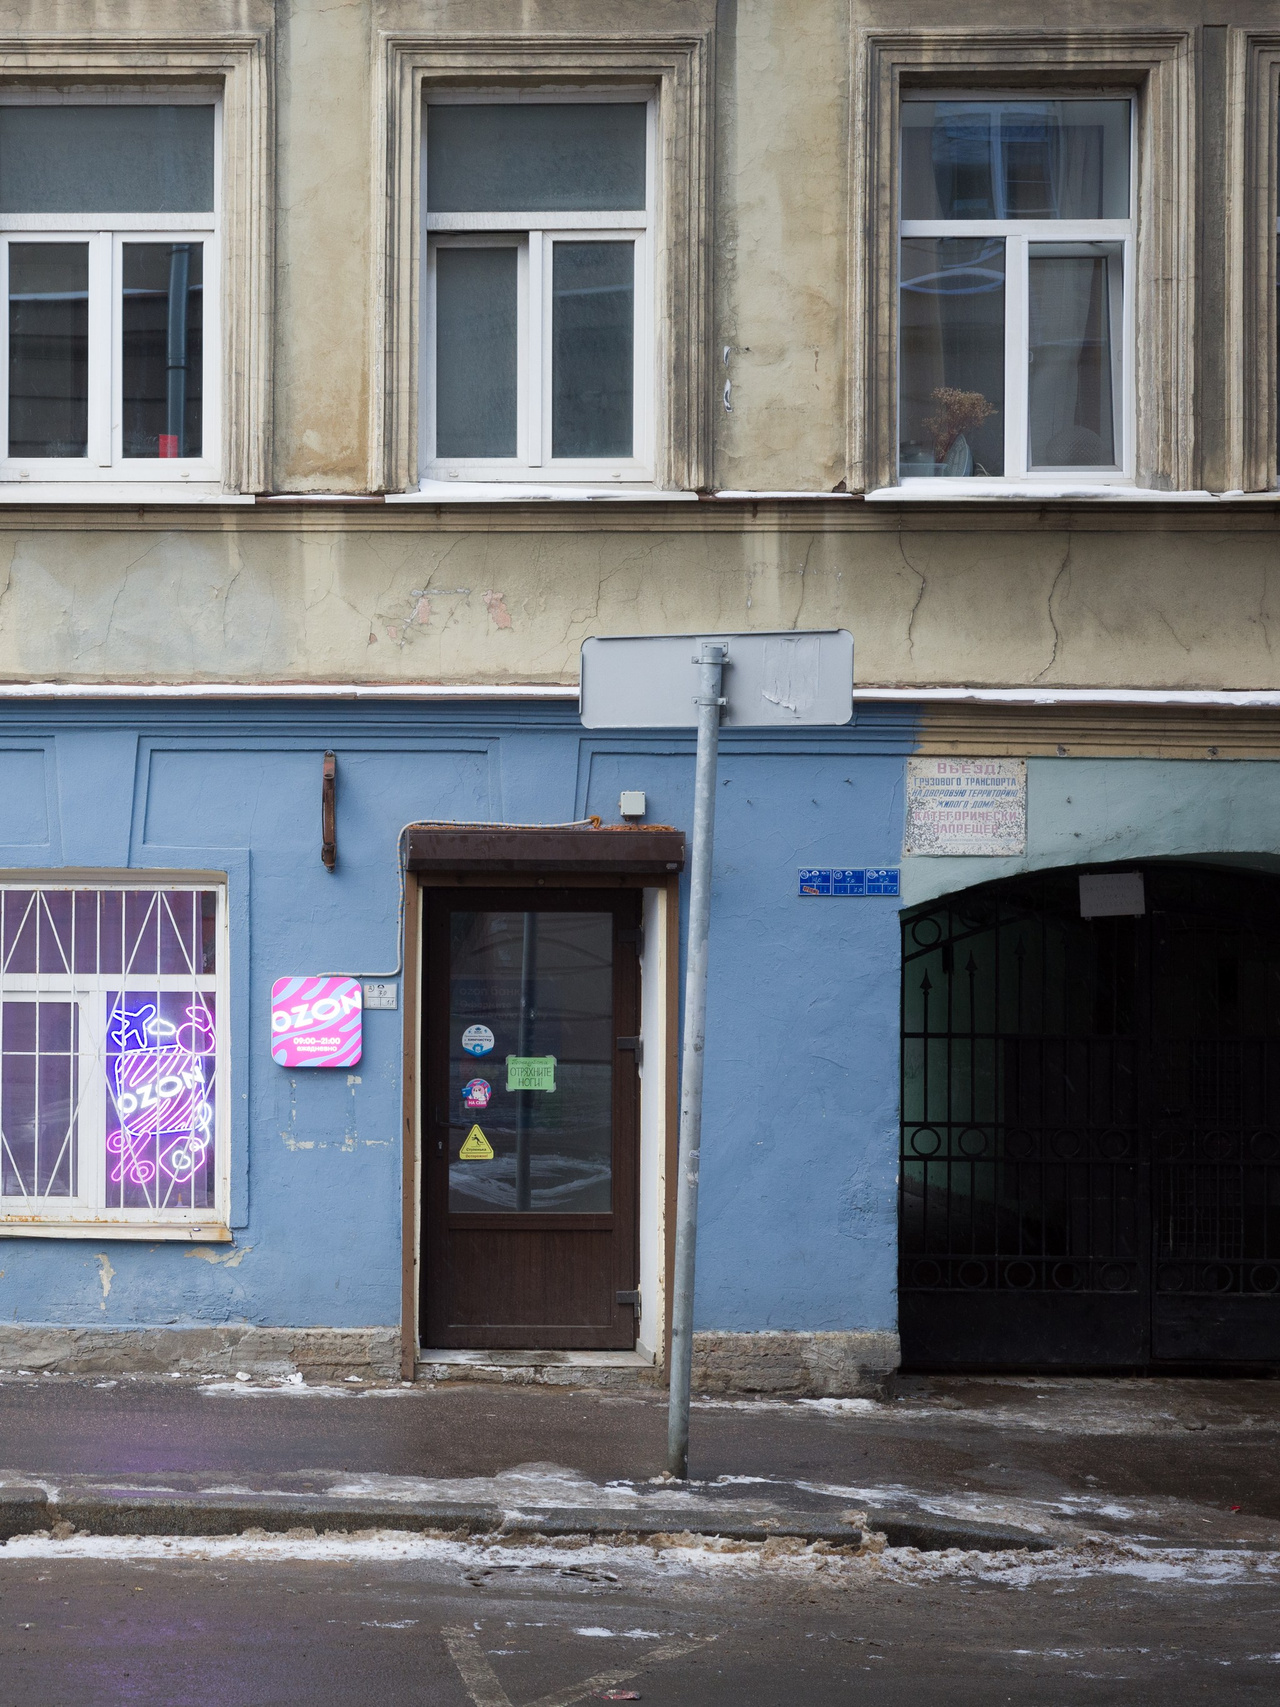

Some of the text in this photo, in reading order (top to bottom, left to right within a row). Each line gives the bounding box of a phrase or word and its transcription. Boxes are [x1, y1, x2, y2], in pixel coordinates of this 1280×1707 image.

[937, 762, 996, 775] ВЪЕЗД
[913, 777, 1017, 787] ГРУЗОВОГО ТРАНСПОРТА
[922, 789, 965, 798] ДВОРОВУЮ
[968, 789, 1019, 798] ТЕРРИТОРИЮ
[935, 800, 995, 809] ЖИЛОГО ДОМА
[914, 811, 1017, 821] КАТЕГОРИЧЕСКИ
[272, 990, 362, 1033] OZON
[296, 1045, 338, 1053] ежедневно
[510, 1067, 552, 1077] ОТРЯХНИТЕ
[117, 1064, 205, 1114] OZON
